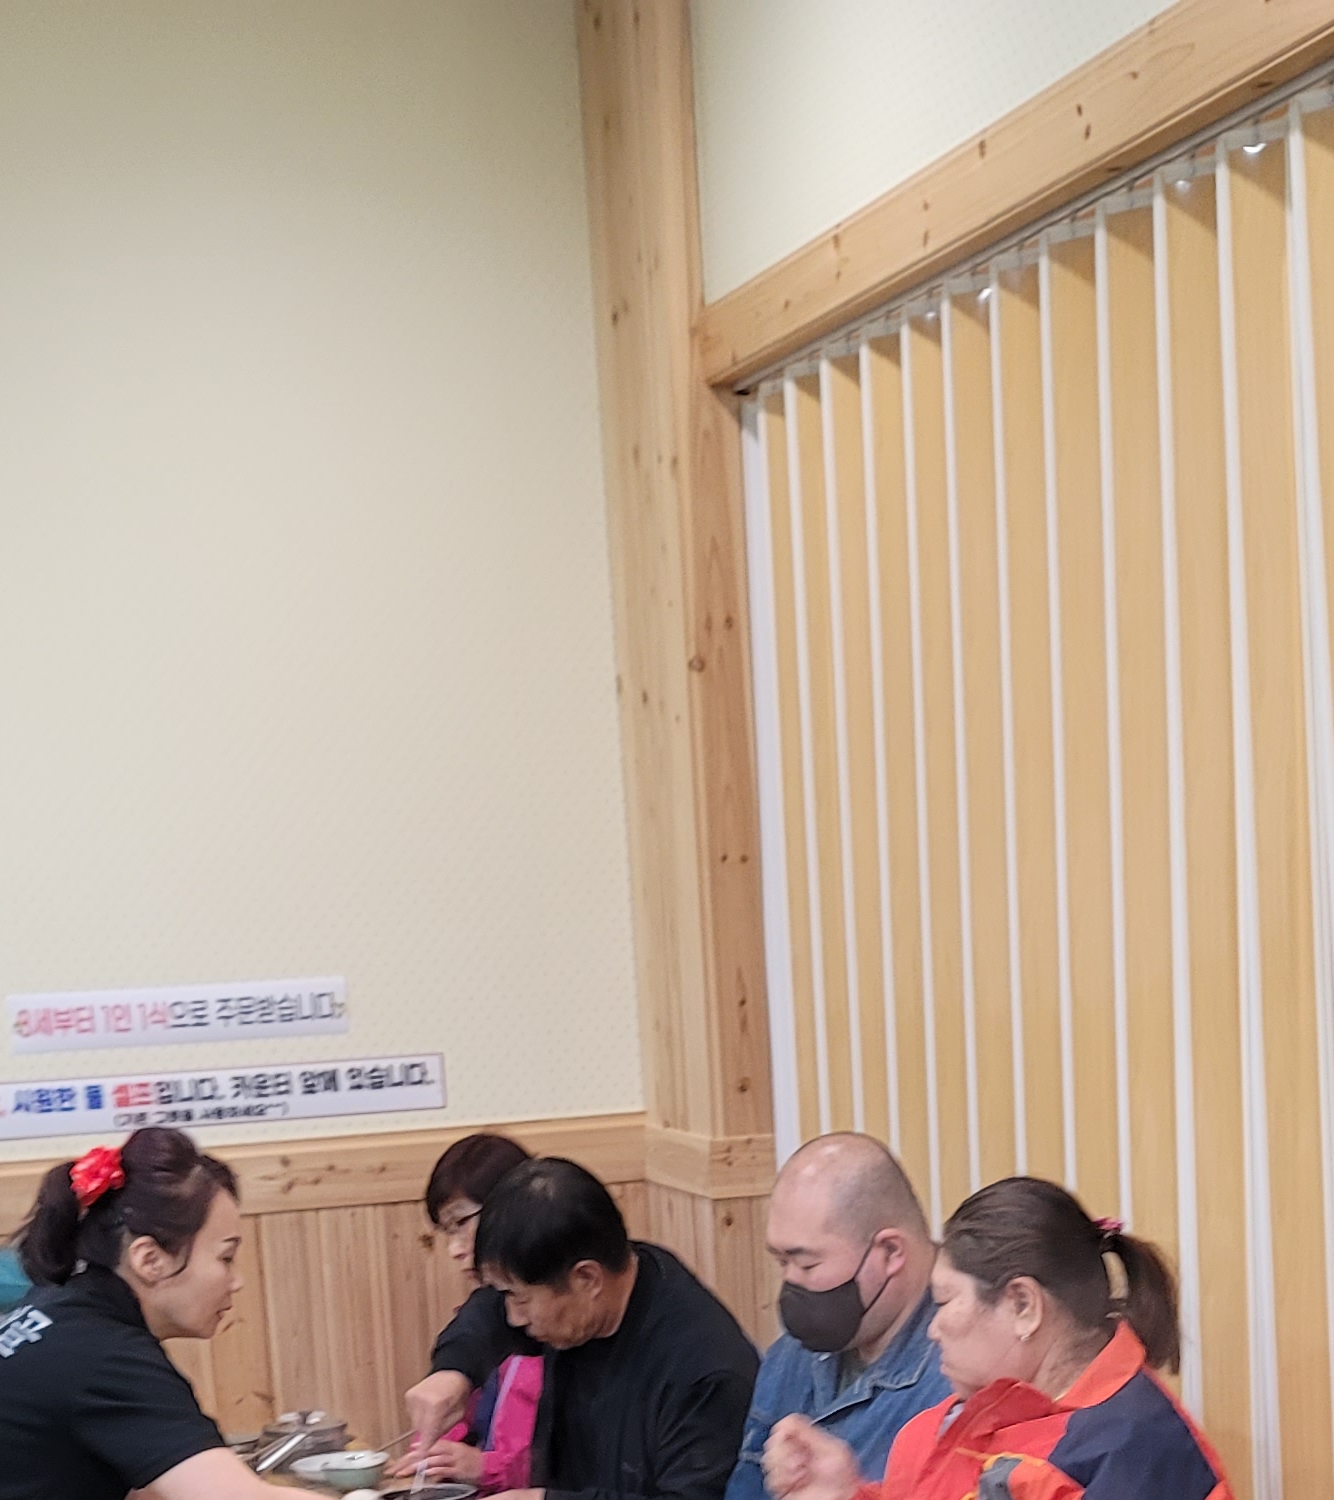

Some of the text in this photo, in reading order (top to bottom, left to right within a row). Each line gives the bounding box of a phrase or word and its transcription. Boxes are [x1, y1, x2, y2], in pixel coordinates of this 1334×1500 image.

[101, 1003, 132, 1034] 1인
[137, 998, 210, 1031] 1식으로
[12, 1086, 77, 1115] 시원한
[84, 1084, 103, 1111] 물
[112, 1074, 226, 1109] 셀프입니다.
[229, 1071, 293, 1100] 카운터
[298, 1068, 340, 1096] 앞에
[345, 1060, 435, 1092] 있습니다.
